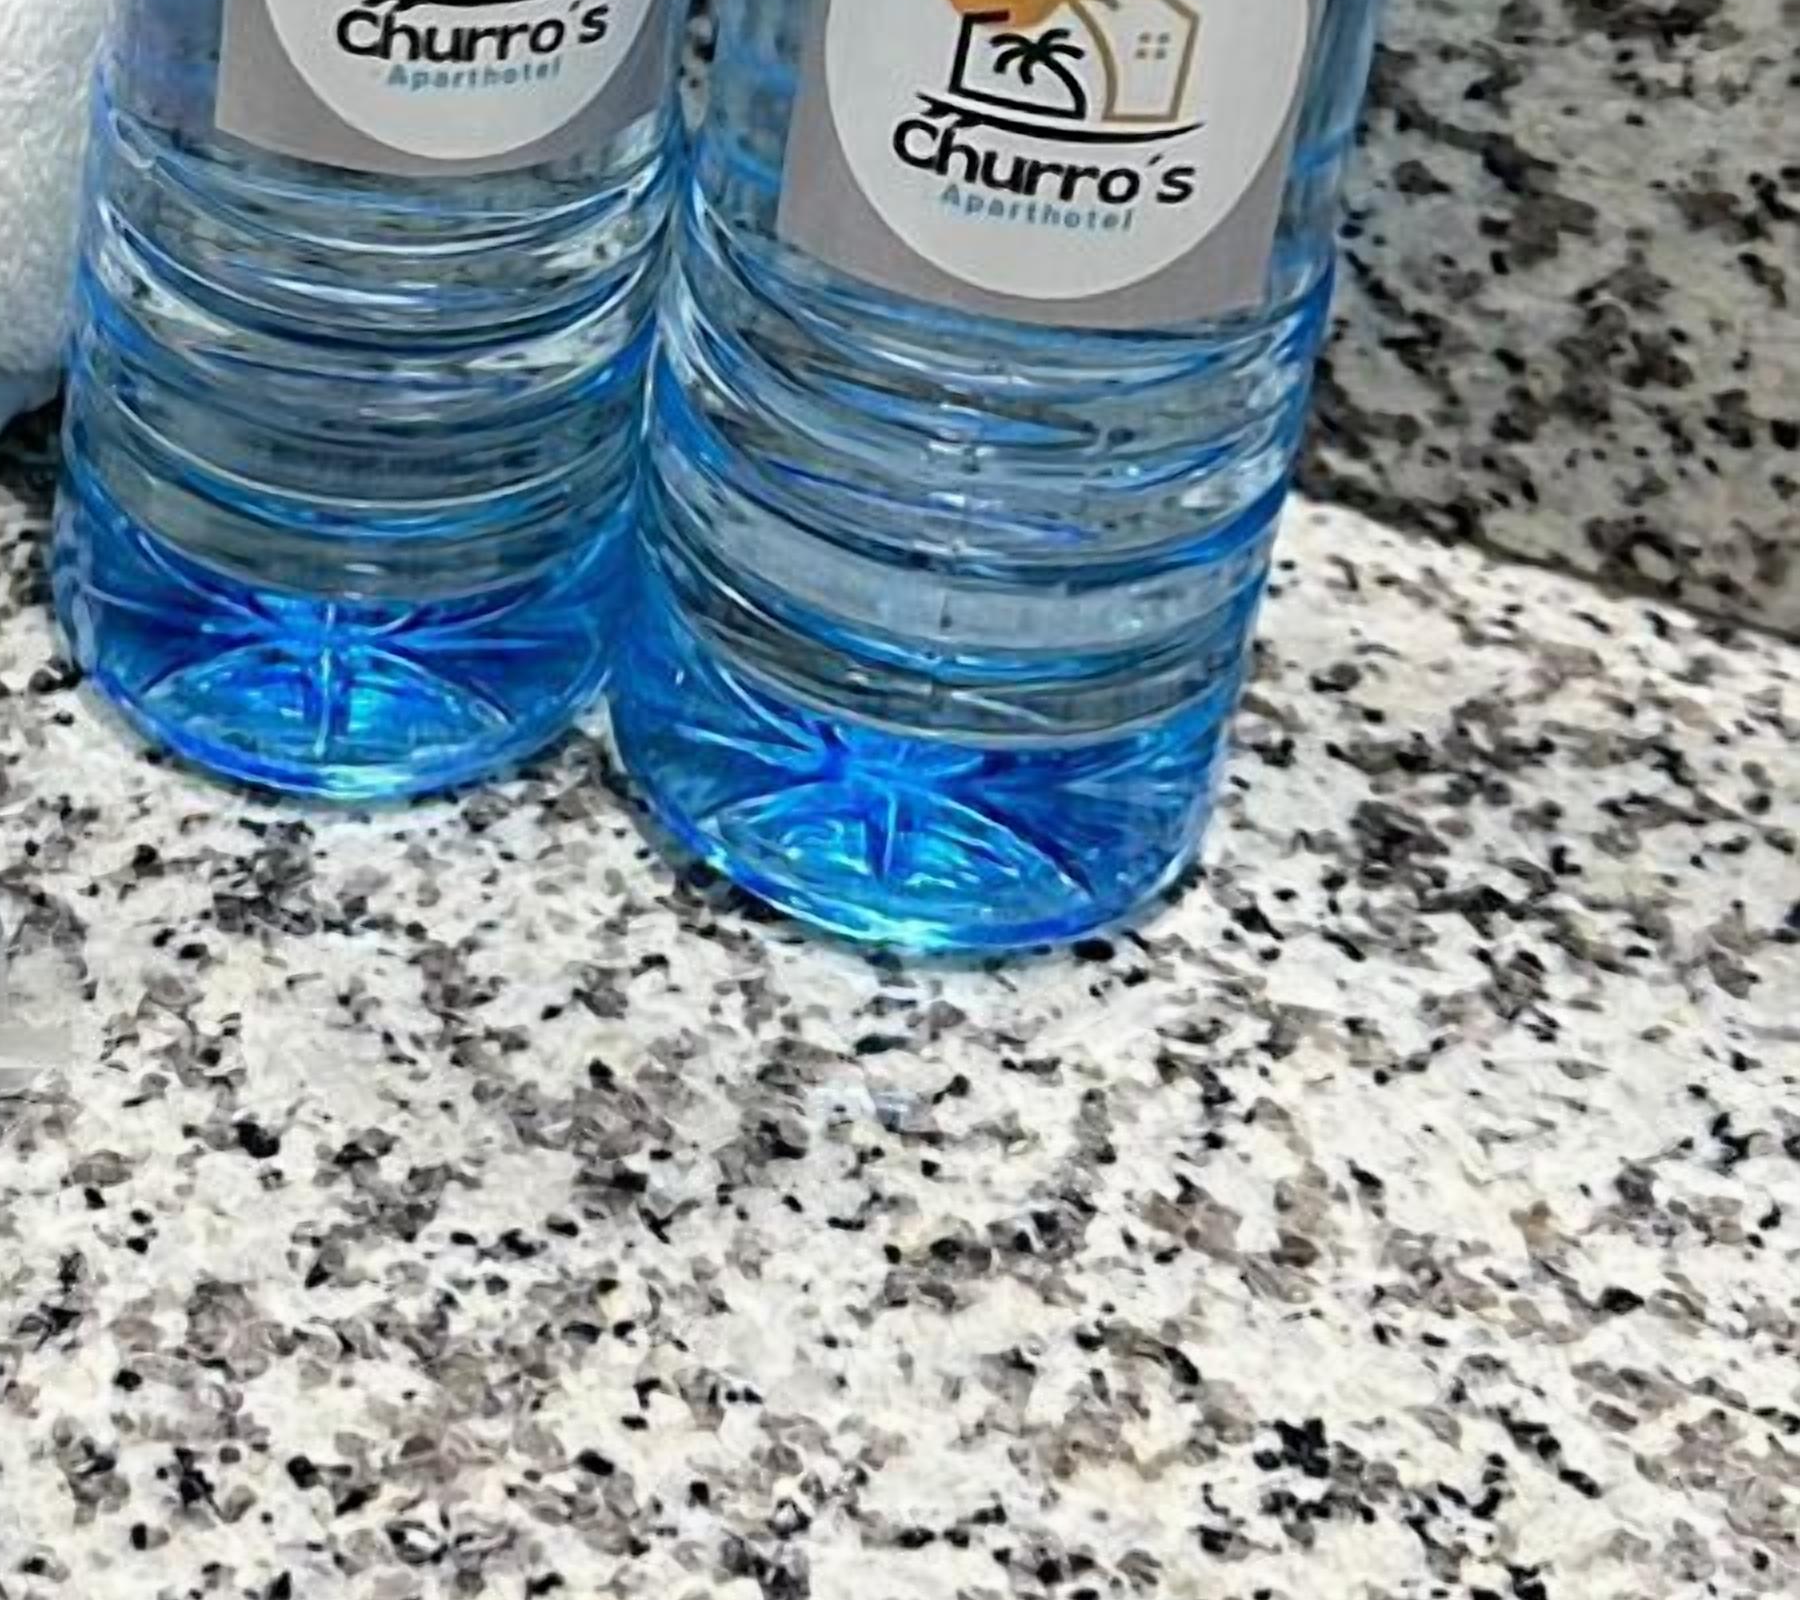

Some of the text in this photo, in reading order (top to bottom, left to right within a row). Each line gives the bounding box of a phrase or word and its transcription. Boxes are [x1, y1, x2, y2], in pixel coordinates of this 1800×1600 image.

[336, 1, 611, 61] Churro's
[386, 58, 562, 92] Aparthotel
[892, 116, 1196, 205] Churro's
[940, 182, 1135, 233] Aparthotel
